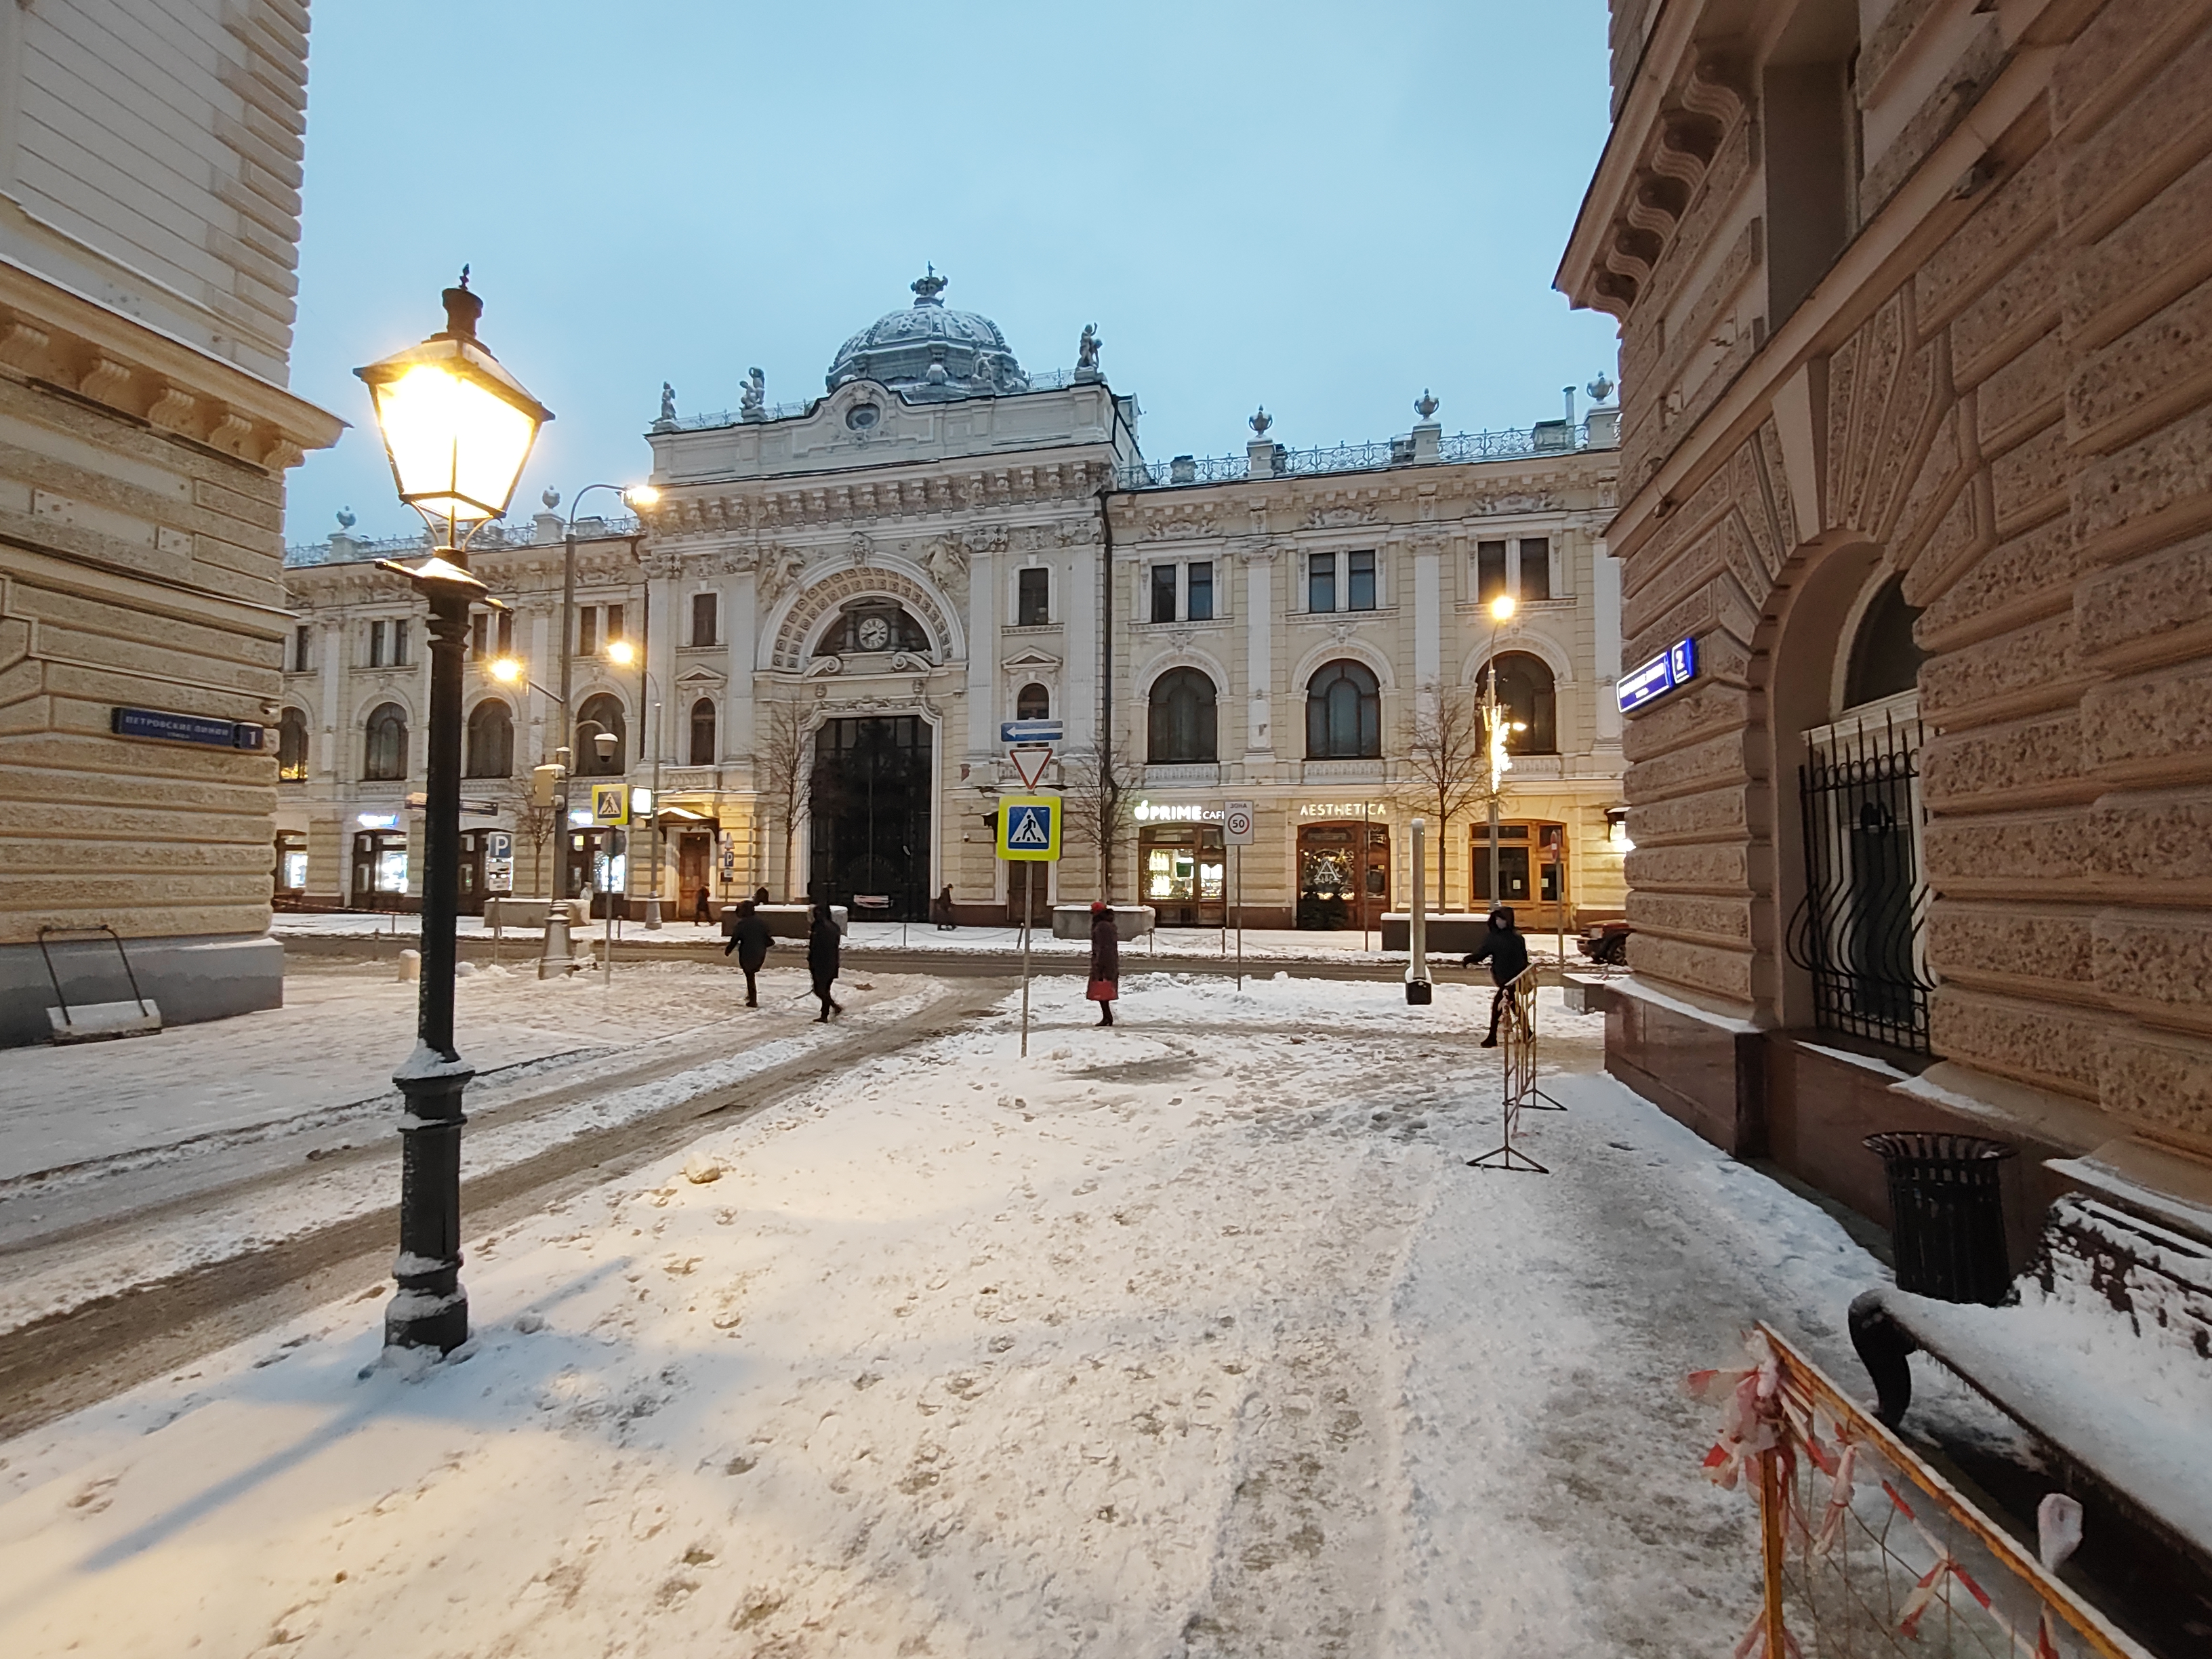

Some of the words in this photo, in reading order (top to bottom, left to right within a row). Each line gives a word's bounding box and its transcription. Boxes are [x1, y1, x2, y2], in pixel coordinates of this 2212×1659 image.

[1675, 650, 1685, 671] 2
[125, 716, 192, 732] ПЕТРОВСКИЕ
[194, 725, 229, 737] ЛИНИИ
[249, 731, 256, 745] 1
[1149, 805, 1202, 821] PRIME
[1300, 803, 1387, 817] AESTHETICA
[1232, 819, 1246, 829] 50
[495, 836, 508, 856] P
